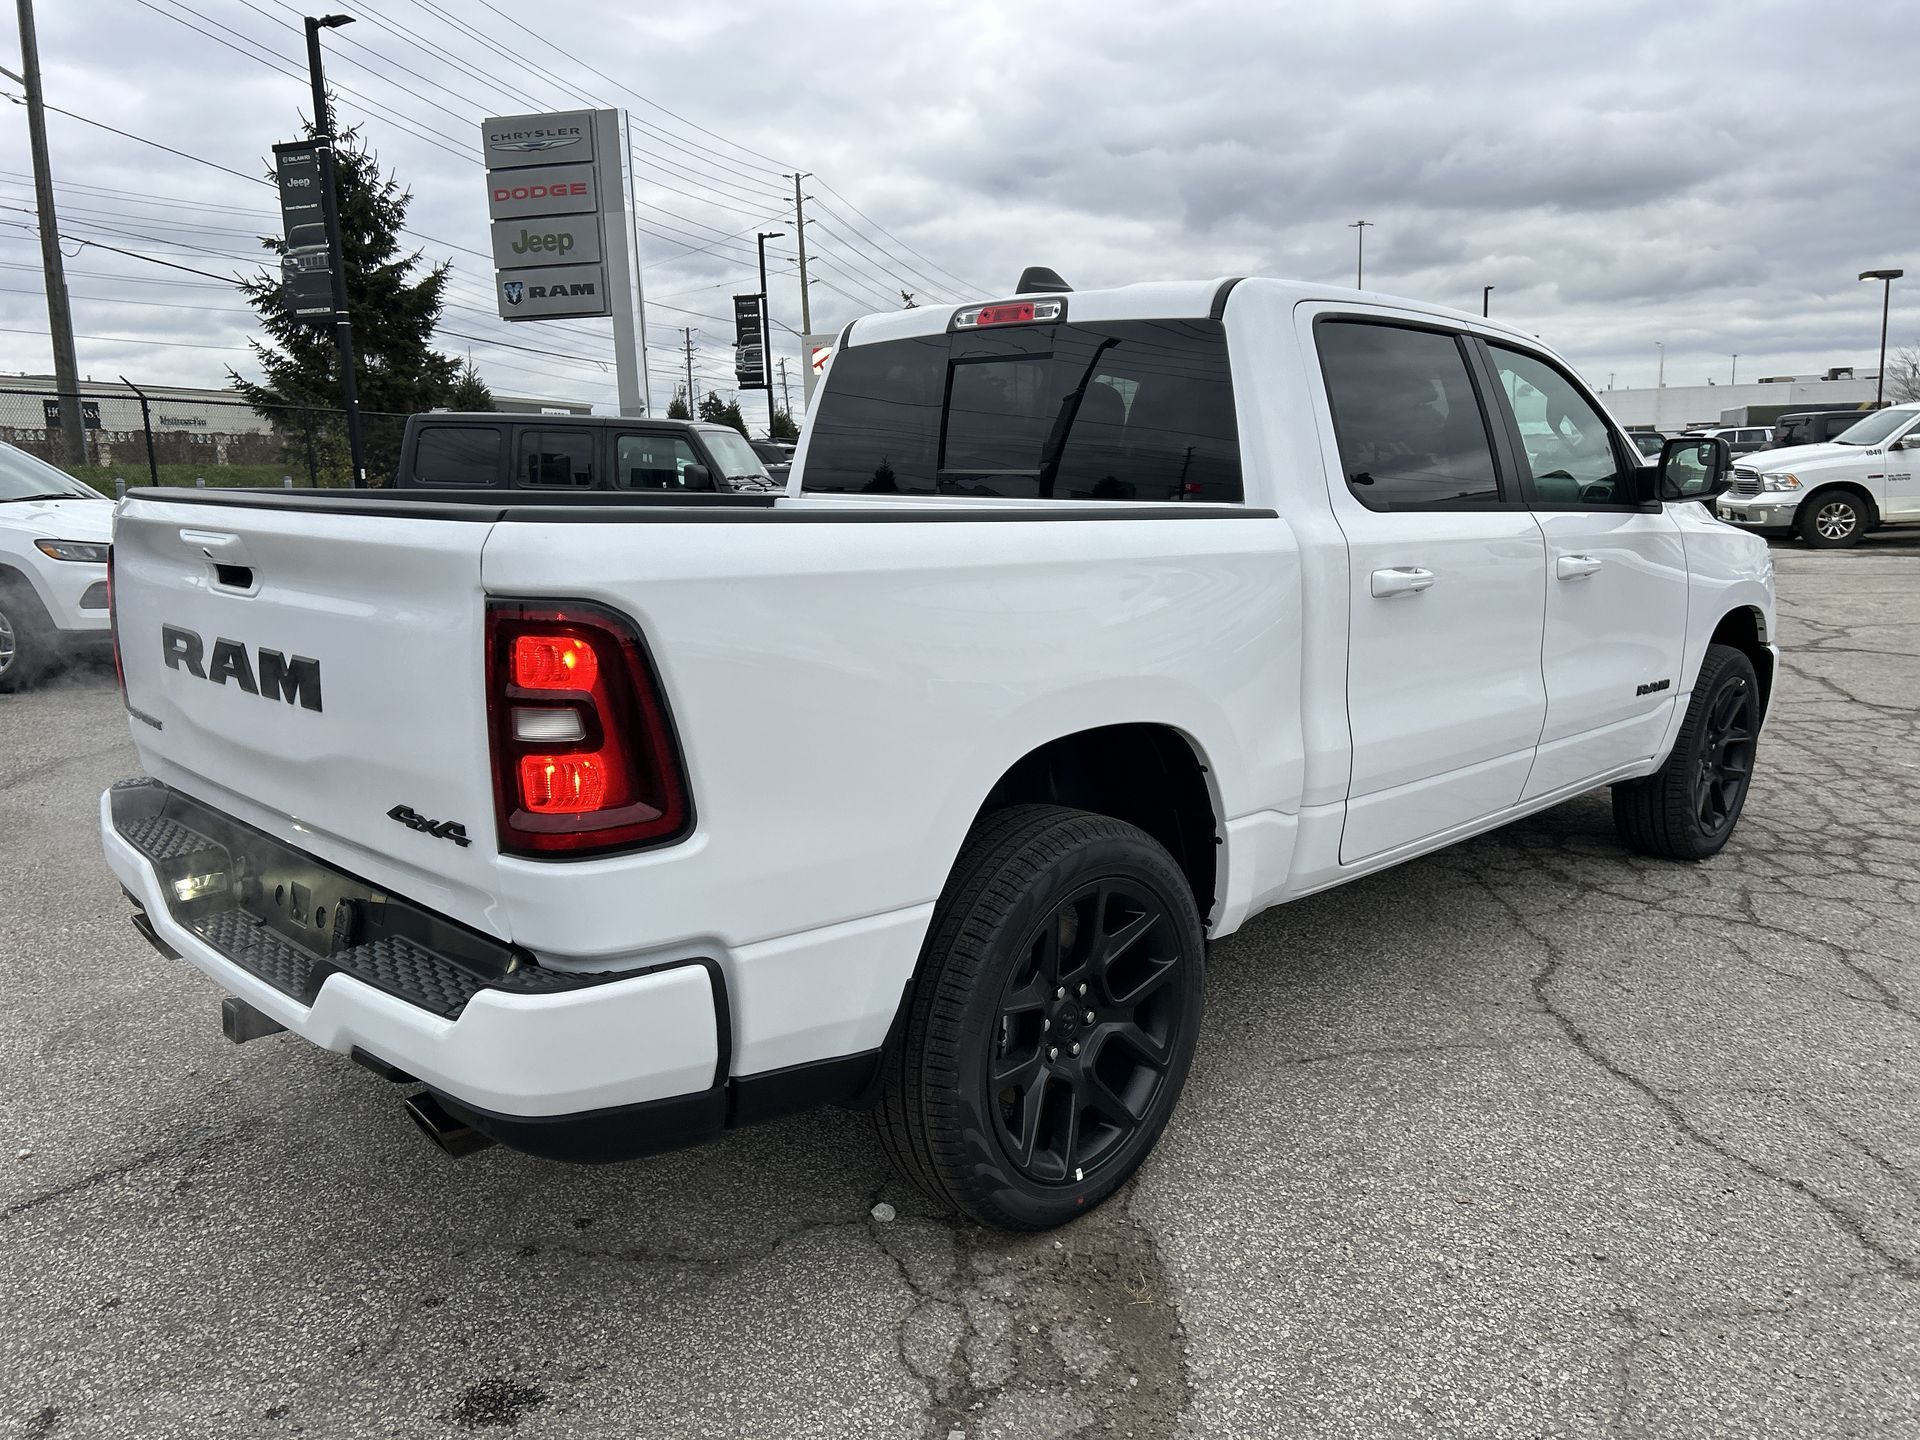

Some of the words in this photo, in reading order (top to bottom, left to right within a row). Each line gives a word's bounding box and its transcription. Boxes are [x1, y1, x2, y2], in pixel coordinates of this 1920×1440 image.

[490, 127, 580, 141] CHRYSLER
[287, 178, 310, 187] Jeep
[494, 182, 587, 202] DODGE
[512, 229, 574, 255] Jeep
[529, 283, 595, 298] RAM
[162, 623, 323, 713] RAM
[1636, 679, 1670, 697] RAM
